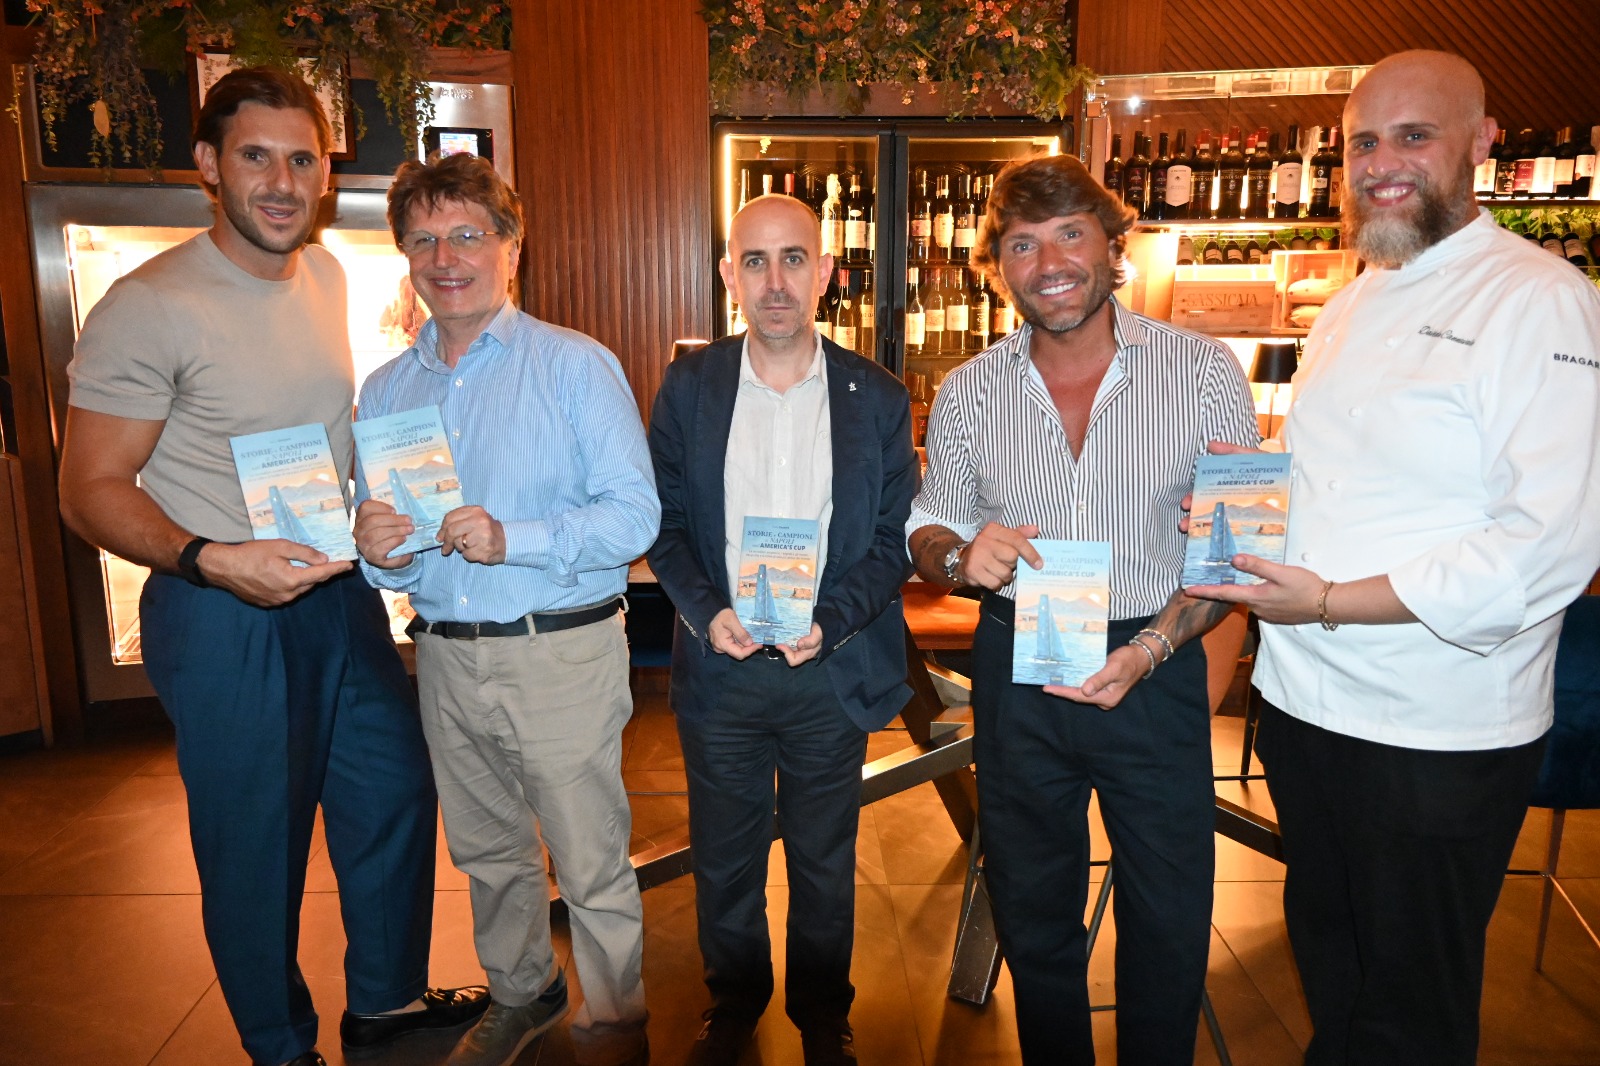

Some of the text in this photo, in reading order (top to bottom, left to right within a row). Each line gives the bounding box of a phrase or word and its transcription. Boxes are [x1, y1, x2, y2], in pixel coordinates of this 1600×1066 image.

[1187, 293, 1259, 307] SASSICAIA
[361, 431, 391, 443] STORIE
[396, 421, 437, 435] CAMPIONI
[240, 448, 273, 459] STORIE
[279, 439, 322, 452] CAMPIONI
[381, 435, 434, 452] AMERICA'S CUP
[261, 456, 303, 469] AMERICA'S
[303, 453, 319, 462] CUP
[747, 530, 773, 538] STORIE
[777, 532, 813, 540] CAMPIONI
[760, 542, 793, 550] AMERICA'S
[1039, 570, 1080, 578] AMERICA'S
